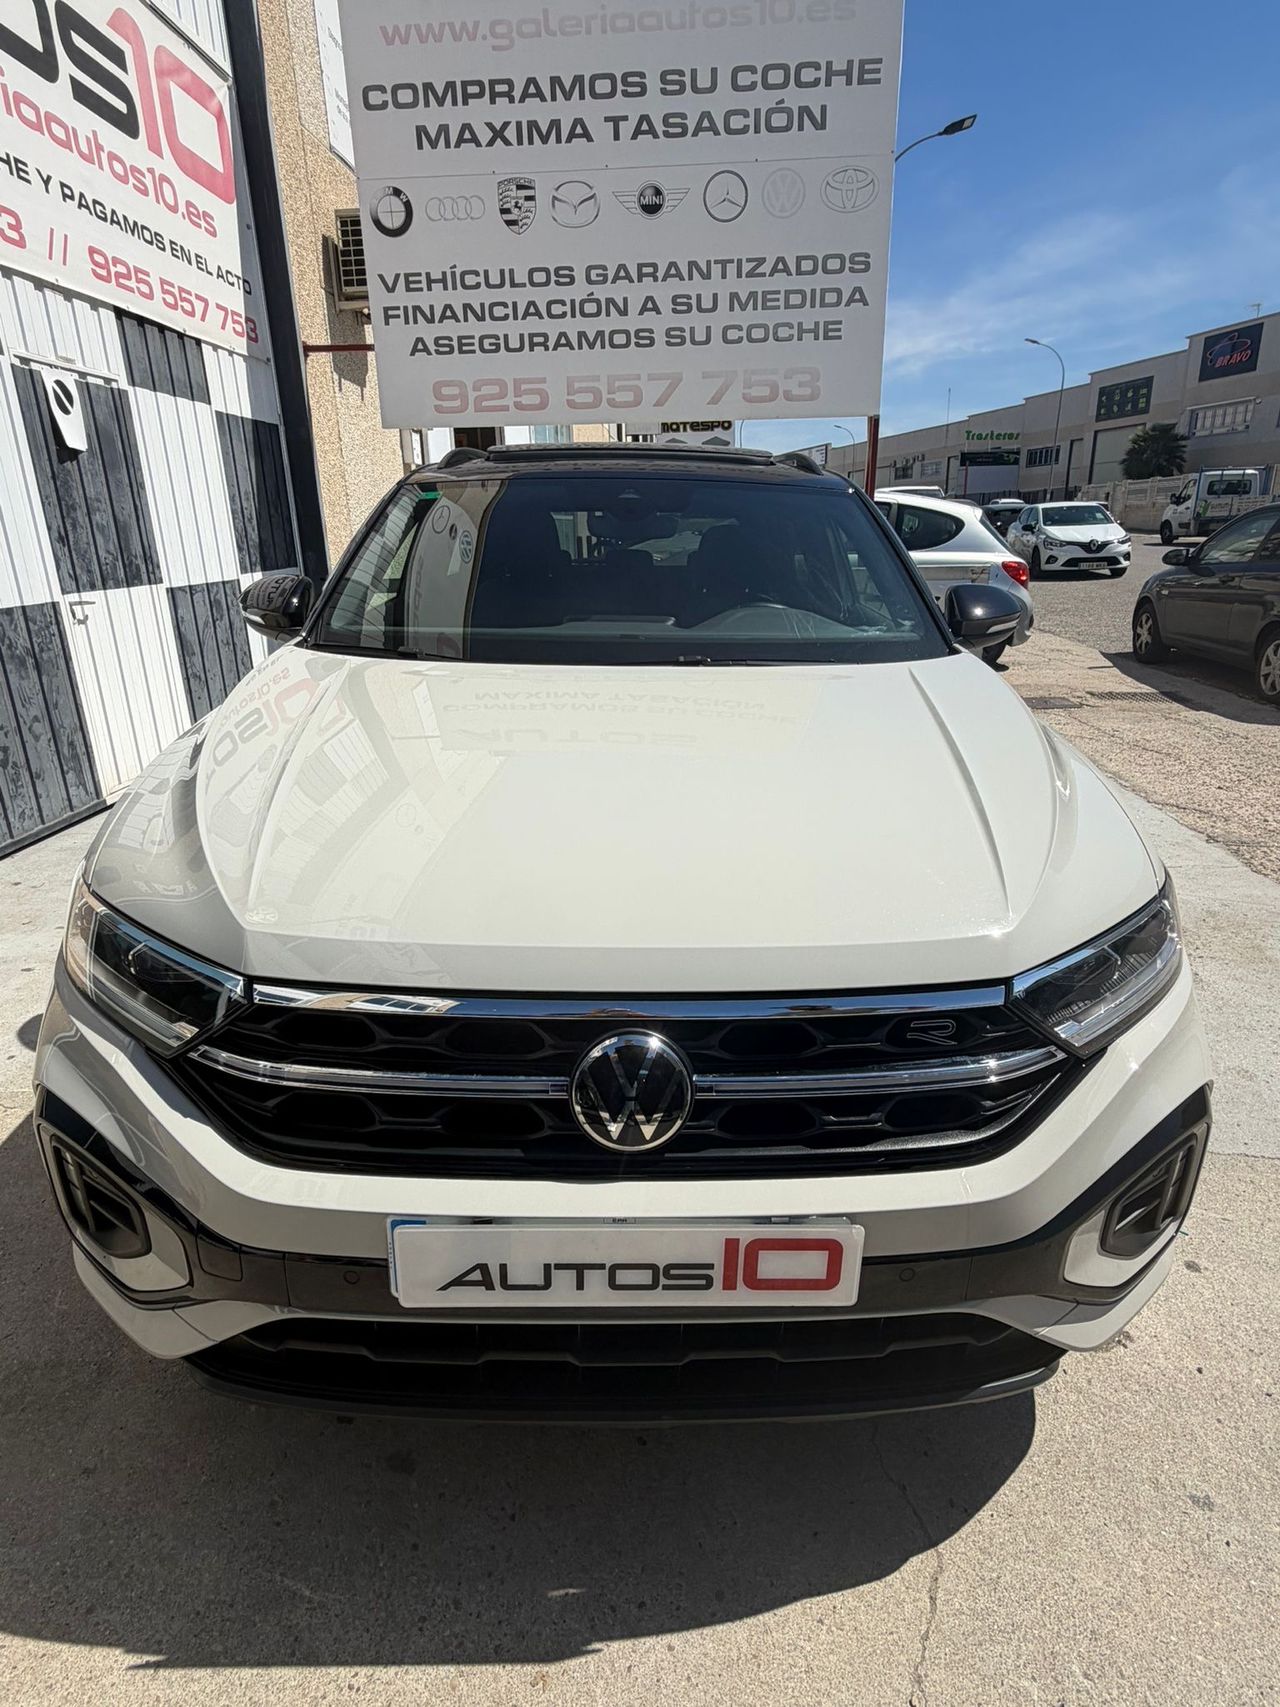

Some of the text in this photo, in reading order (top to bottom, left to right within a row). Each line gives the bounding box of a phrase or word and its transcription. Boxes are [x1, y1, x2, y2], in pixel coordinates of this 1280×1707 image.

[379, 0, 857, 52] www.galeriaautos10.es
[361, 70, 648, 112] COMPRAMOS
[659, 67, 718, 96] SU
[730, 57, 884, 93] COCHE
[415, 98, 828, 150] MAXIMA TASACIÓN
[640, 195, 664, 206] MINI
[35, 167, 53, 195] Y
[59, 180, 167, 253] PAGAMOS
[168, 239, 193, 267] EN
[194, 253, 215, 277] EL
[216, 265, 253, 296] ACTO
[87, 245, 155, 302] 925
[159, 276, 210, 323] 557
[215, 301, 259, 344] 753
[377, 252, 871, 294] VEHÍCULOS GARANTIZADOS
[382, 285, 870, 326] FINANCIACIÓN A SU MEDIDA
[408, 320, 844, 357] ASEGURAMOS SU COCHE
[1213, 350, 1252, 369] BRAVO
[431, 366, 822, 415] 925 557 753
[436, 1236, 844, 1292] AUTOS10
